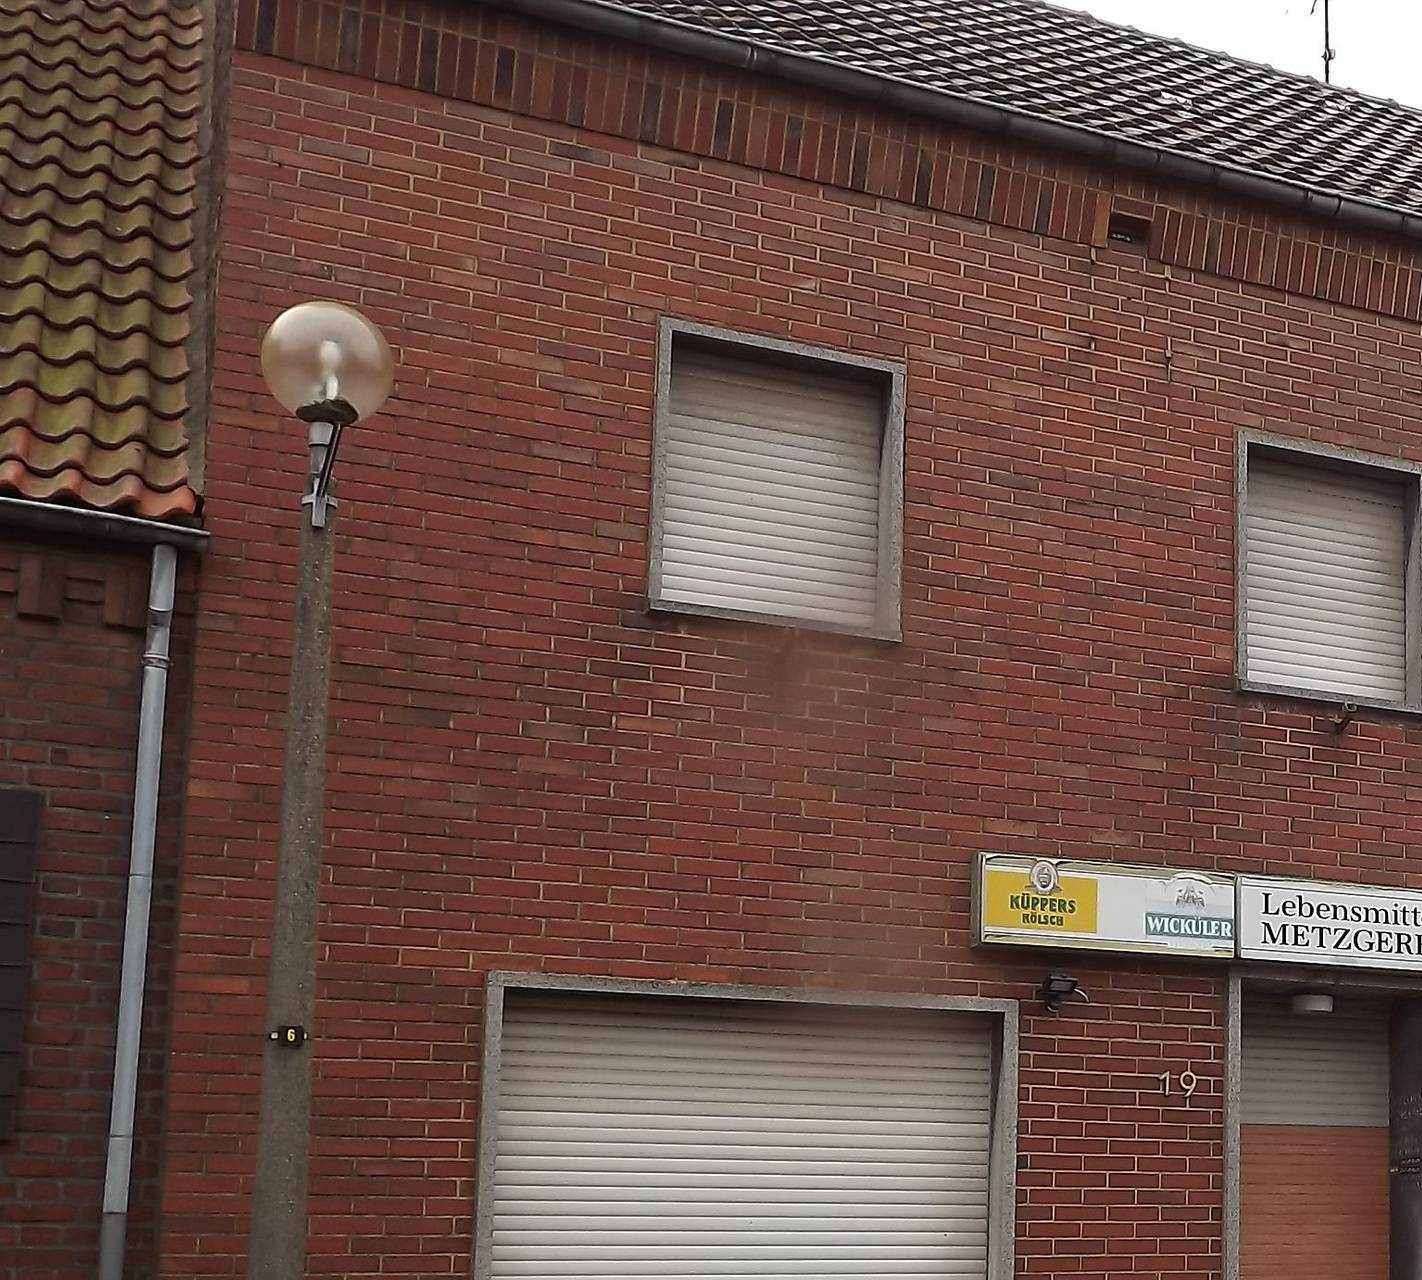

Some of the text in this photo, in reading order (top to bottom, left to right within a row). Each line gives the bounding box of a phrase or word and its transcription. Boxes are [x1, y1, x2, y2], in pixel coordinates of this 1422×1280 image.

[1009, 893, 1077, 915] KÜPPERS
[1021, 912, 1064, 927] KÖLSCH
[1148, 915, 1233, 938] WICKÜLER
[287, 1029, 296, 1042] 6
[1158, 1071, 1197, 1097] 19
